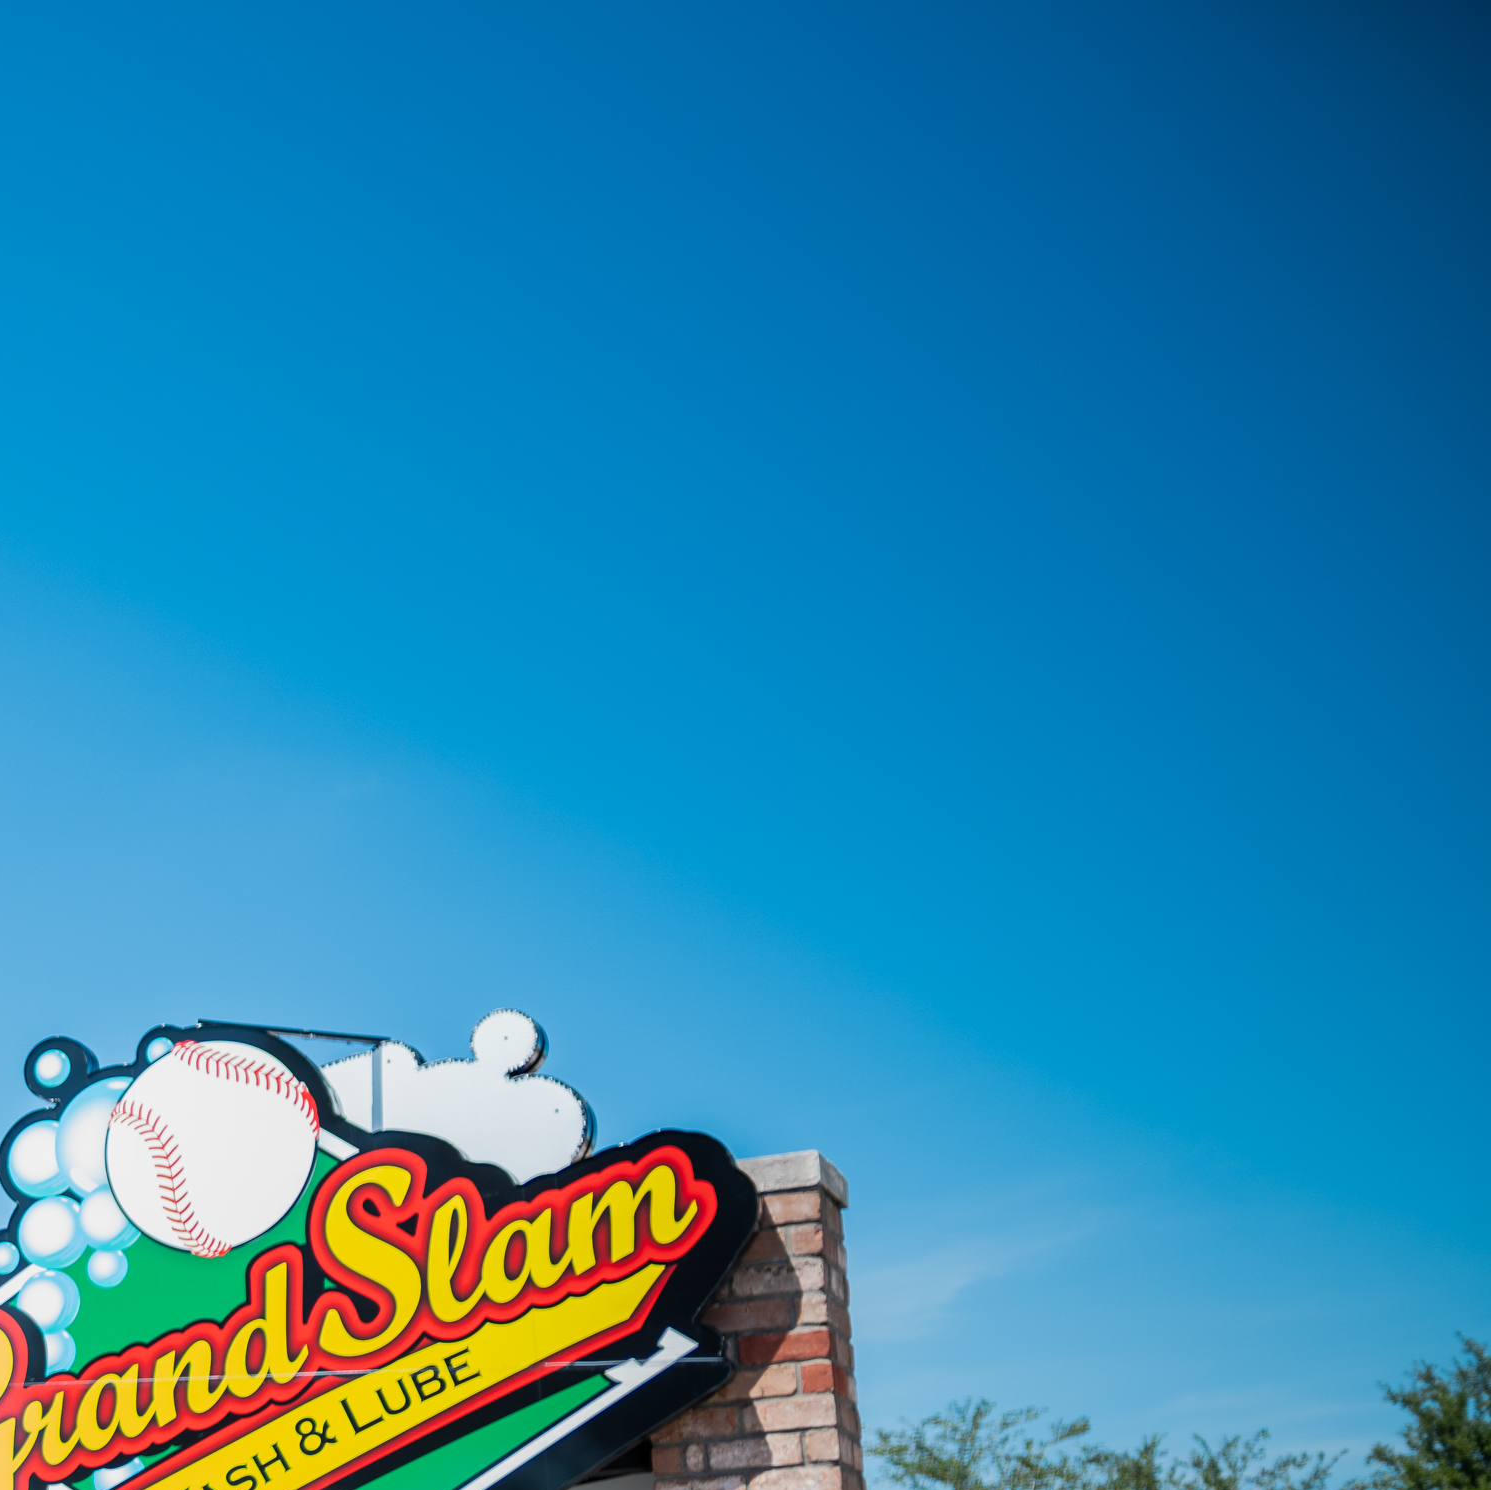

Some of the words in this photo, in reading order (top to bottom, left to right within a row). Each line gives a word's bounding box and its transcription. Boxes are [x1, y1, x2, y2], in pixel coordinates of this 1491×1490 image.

[319, 1165, 698, 1357] Slam
[295, 1417, 337, 1456] &
[339, 1347, 483, 1435] LUBE
